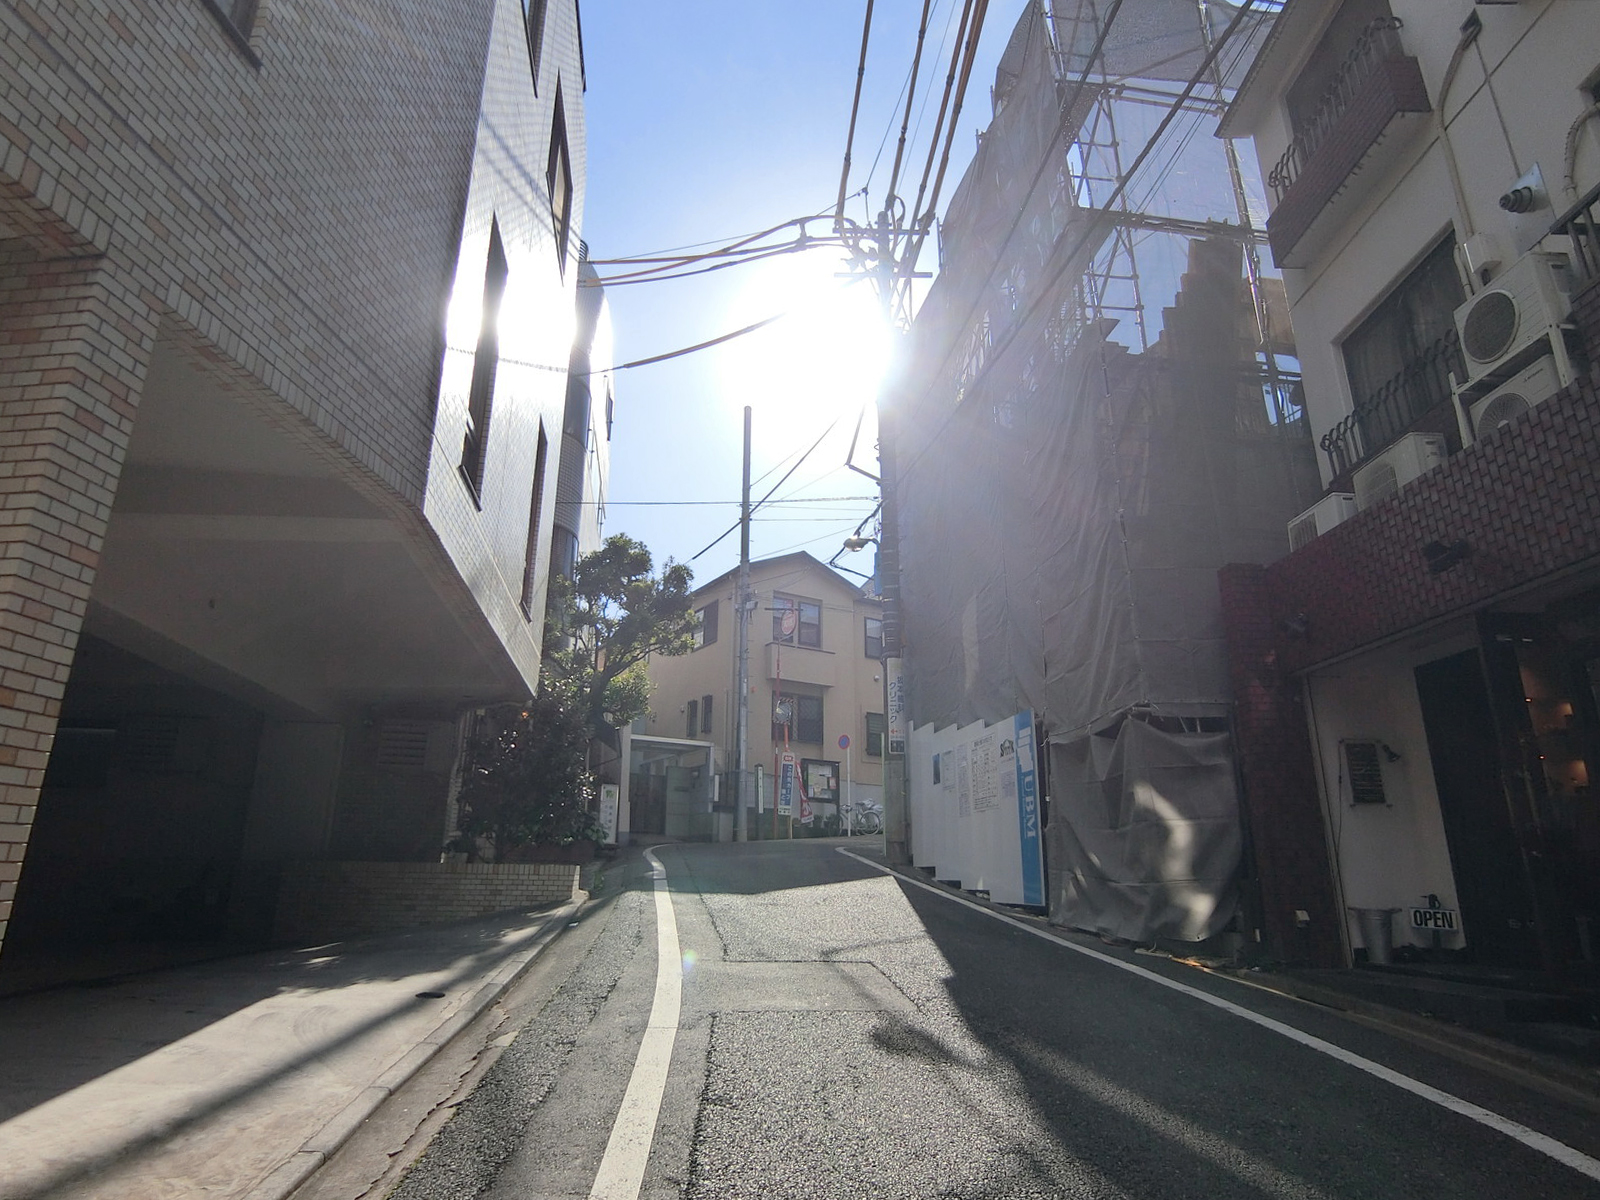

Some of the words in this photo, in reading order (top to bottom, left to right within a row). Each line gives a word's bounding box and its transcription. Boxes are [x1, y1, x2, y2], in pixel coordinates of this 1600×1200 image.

[889, 682, 897, 724] クリニック
[1024, 775, 1036, 838] UBM
[1413, 909, 1454, 929] OPEN
